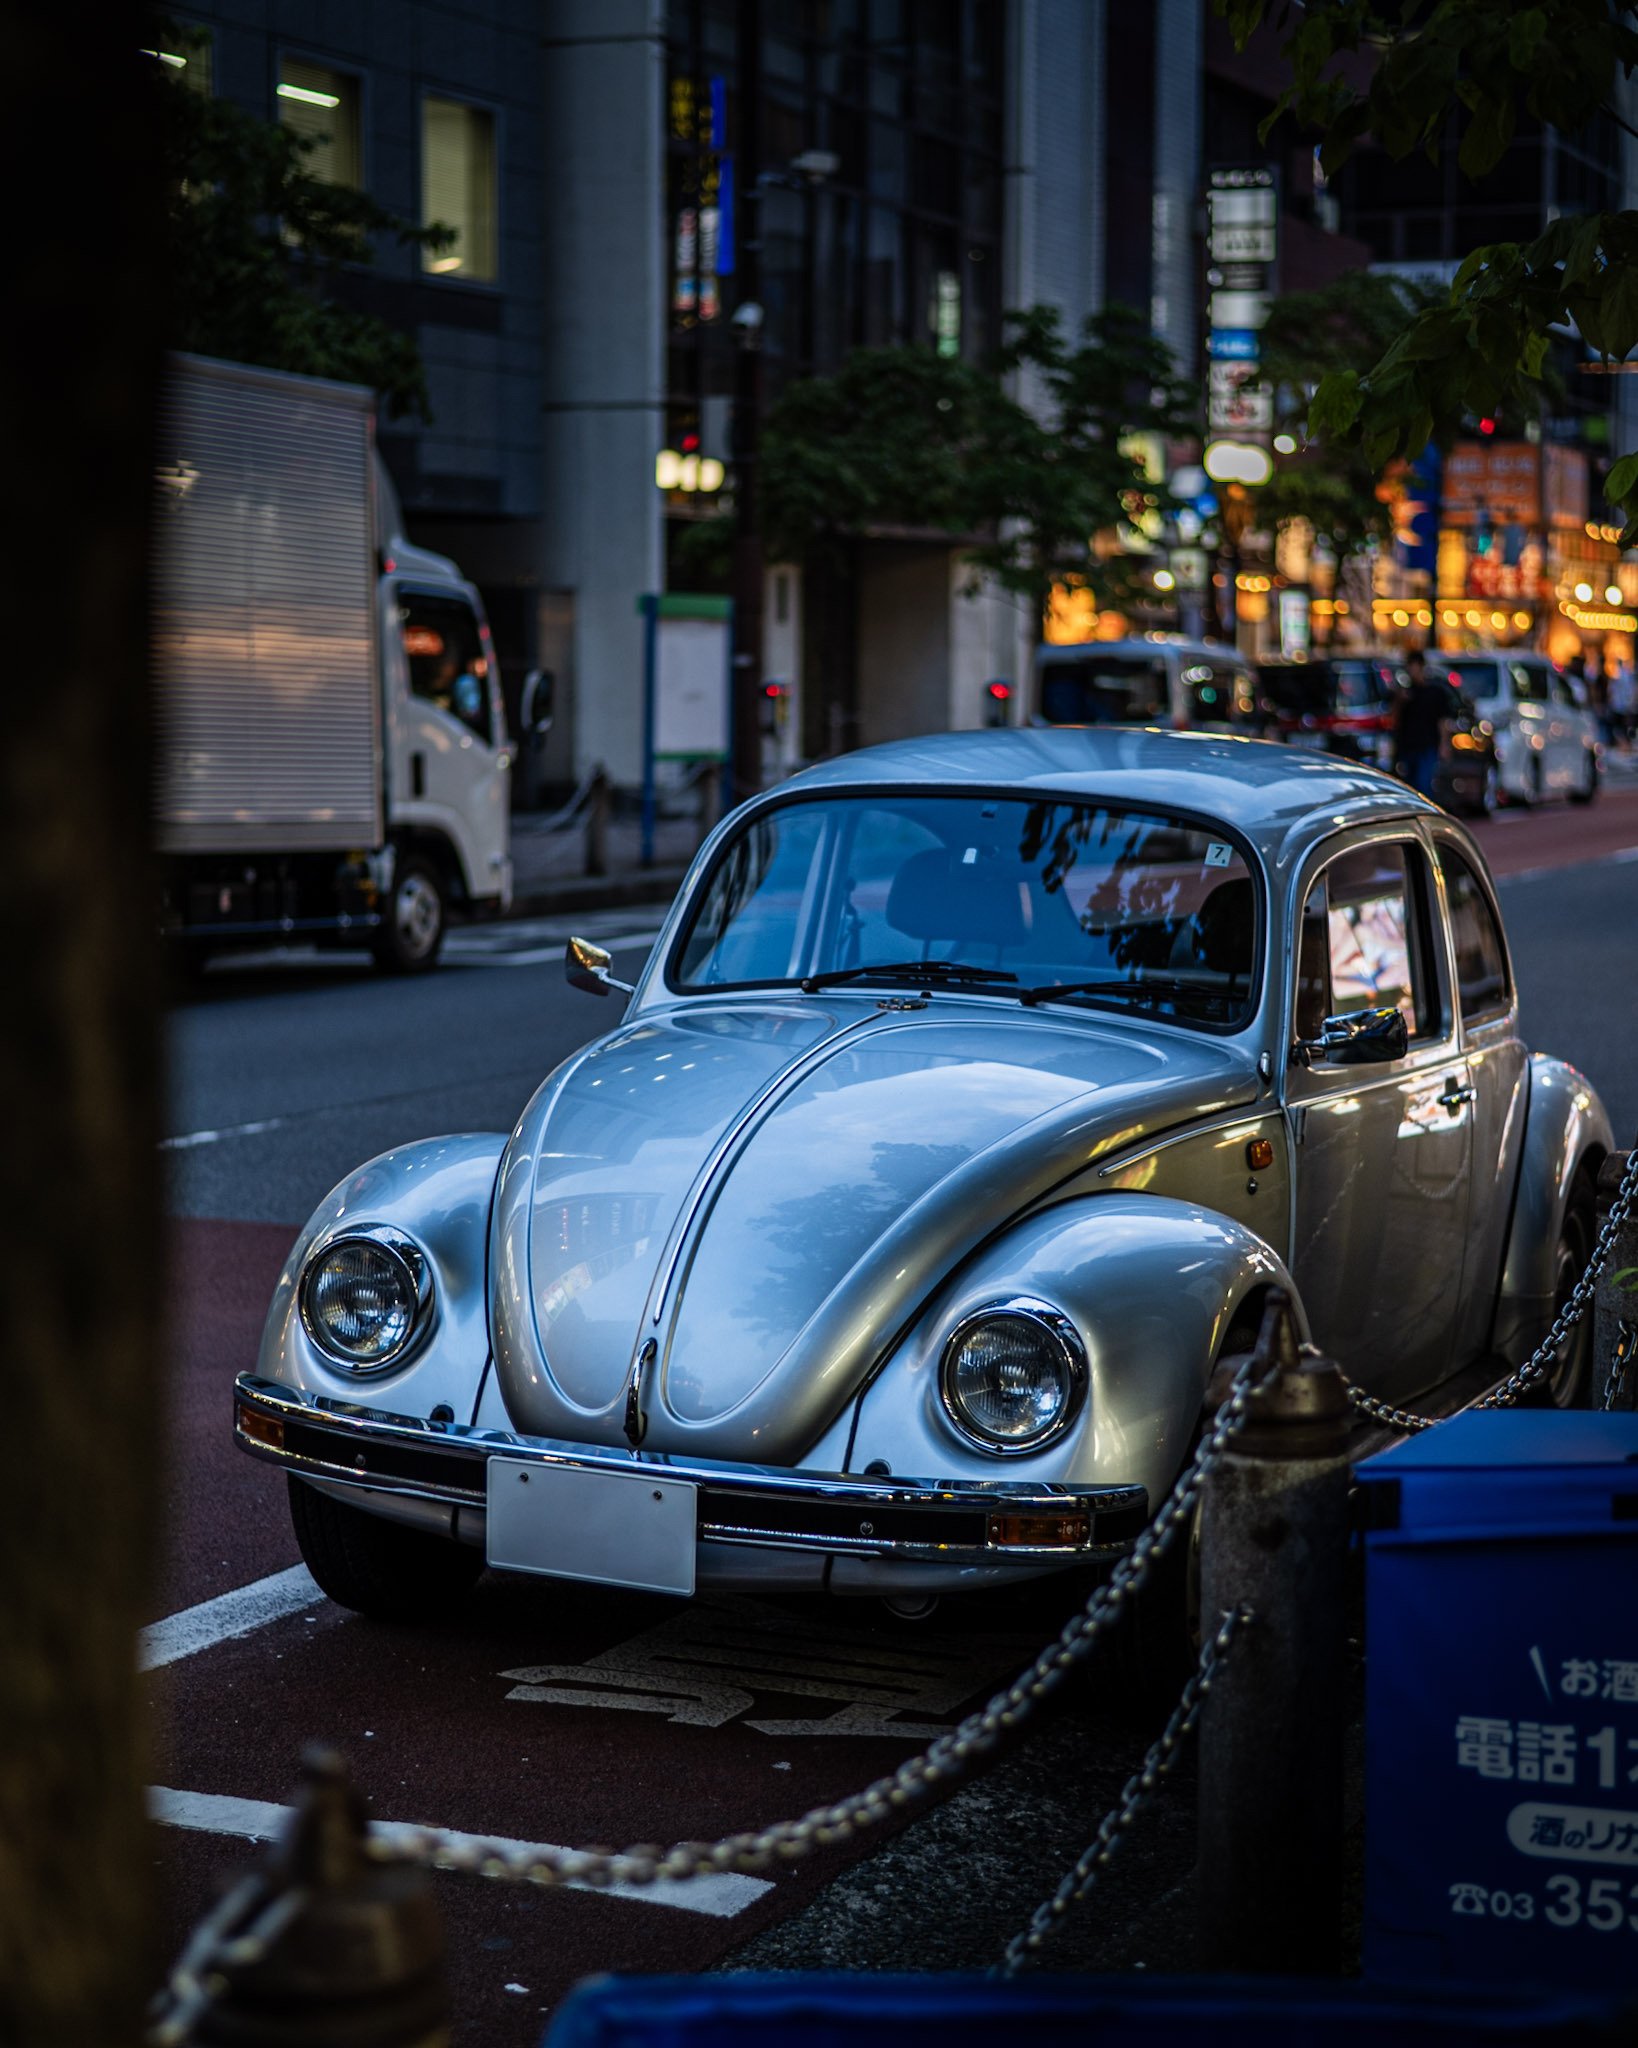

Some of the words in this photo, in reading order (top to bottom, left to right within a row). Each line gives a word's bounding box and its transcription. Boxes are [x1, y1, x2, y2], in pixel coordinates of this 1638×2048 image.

[1214, 846, 1225, 859] 7
[1560, 1657, 1638, 1702] お酒
[1455, 1715, 1638, 1788] 電話1
[1490, 1890, 1535, 1921] 03
[1544, 1873, 1638, 1932] 35
